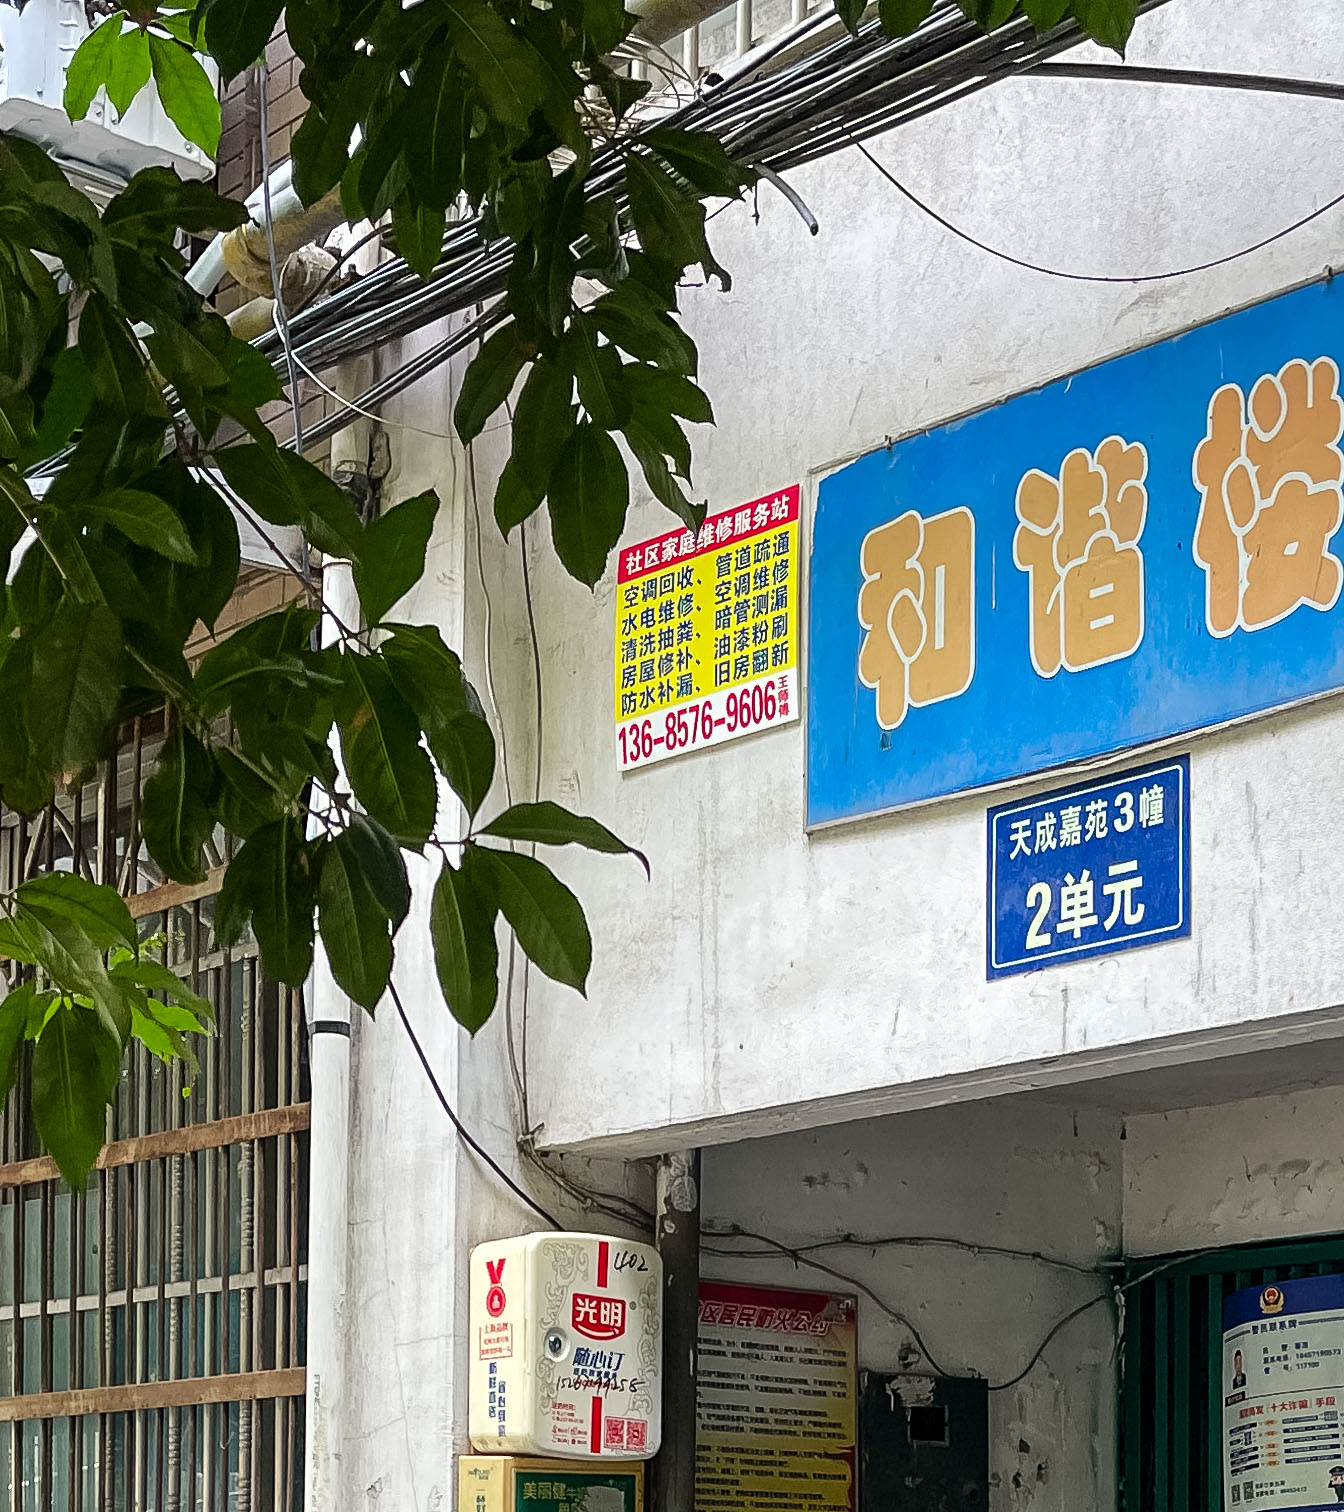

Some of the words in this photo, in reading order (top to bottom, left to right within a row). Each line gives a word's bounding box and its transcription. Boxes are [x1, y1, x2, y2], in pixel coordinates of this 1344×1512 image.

[624, 494, 791, 576] 社区家庭维修服务站
[714, 531, 791, 579] 管道疏通
[714, 559, 790, 605] 空调维修
[714, 588, 789, 631] 暗管测漏
[714, 613, 789, 660] 油漆粉刷
[714, 640, 789, 688] 旧房翻新
[618, 680, 777, 766] 136-8576-9606
[1009, 783, 1165, 861] 天成嘉苑3幢
[1025, 859, 1145, 950] 2单元
[613, 1249, 649, 1273] 402
[575, 1297, 622, 1328] 光明
